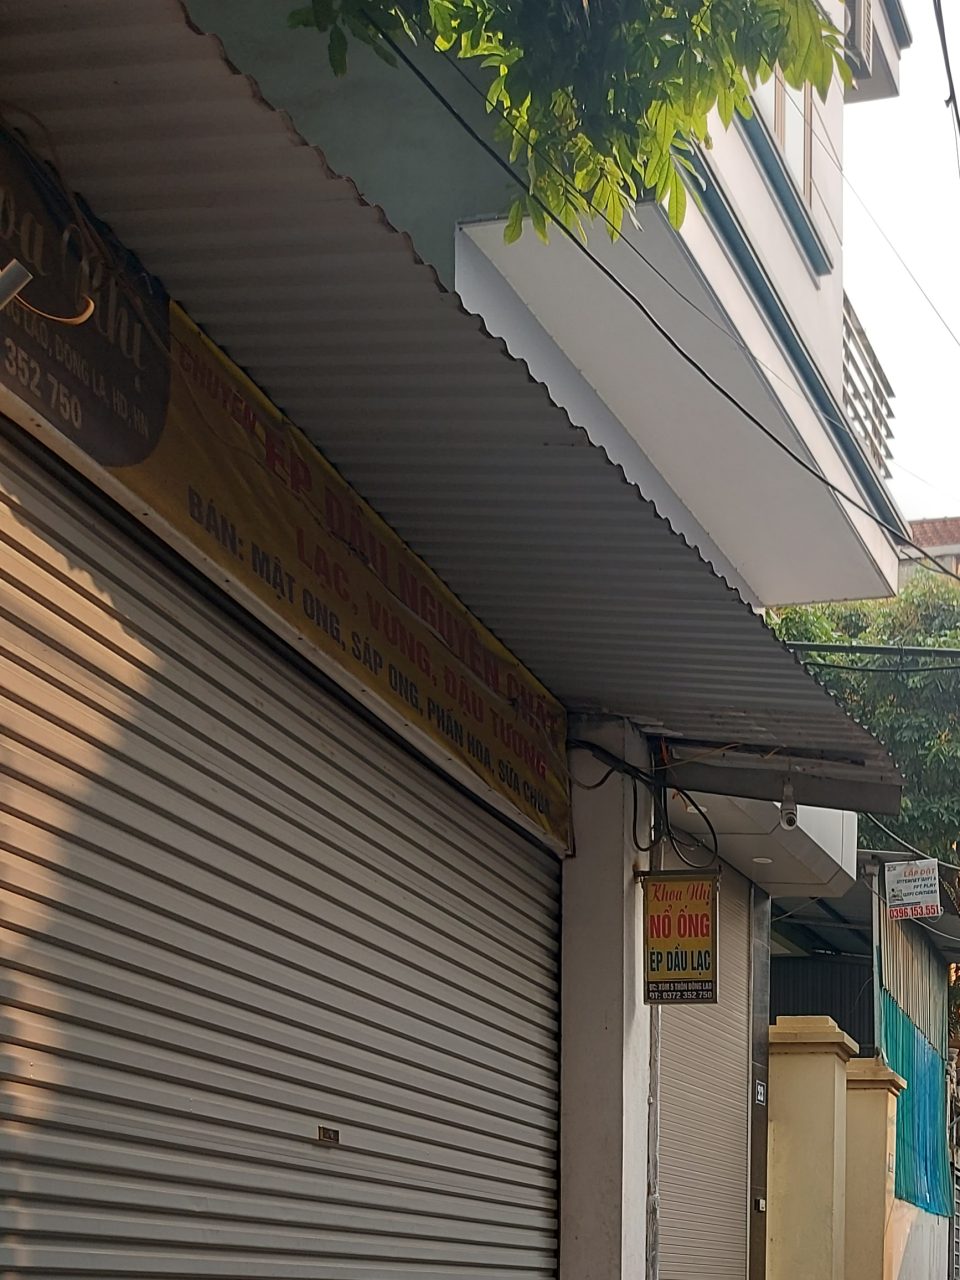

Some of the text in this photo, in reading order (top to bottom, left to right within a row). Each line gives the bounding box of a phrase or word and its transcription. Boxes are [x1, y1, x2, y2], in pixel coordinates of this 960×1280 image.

[4, 337, 82, 430] 352 750
[650, 904, 710, 939] NỔ ỐNG
[889, 903, 939, 920] 0396.153.551
[649, 946, 663, 972] ÉP
[690, 949, 711, 976] LẠC
